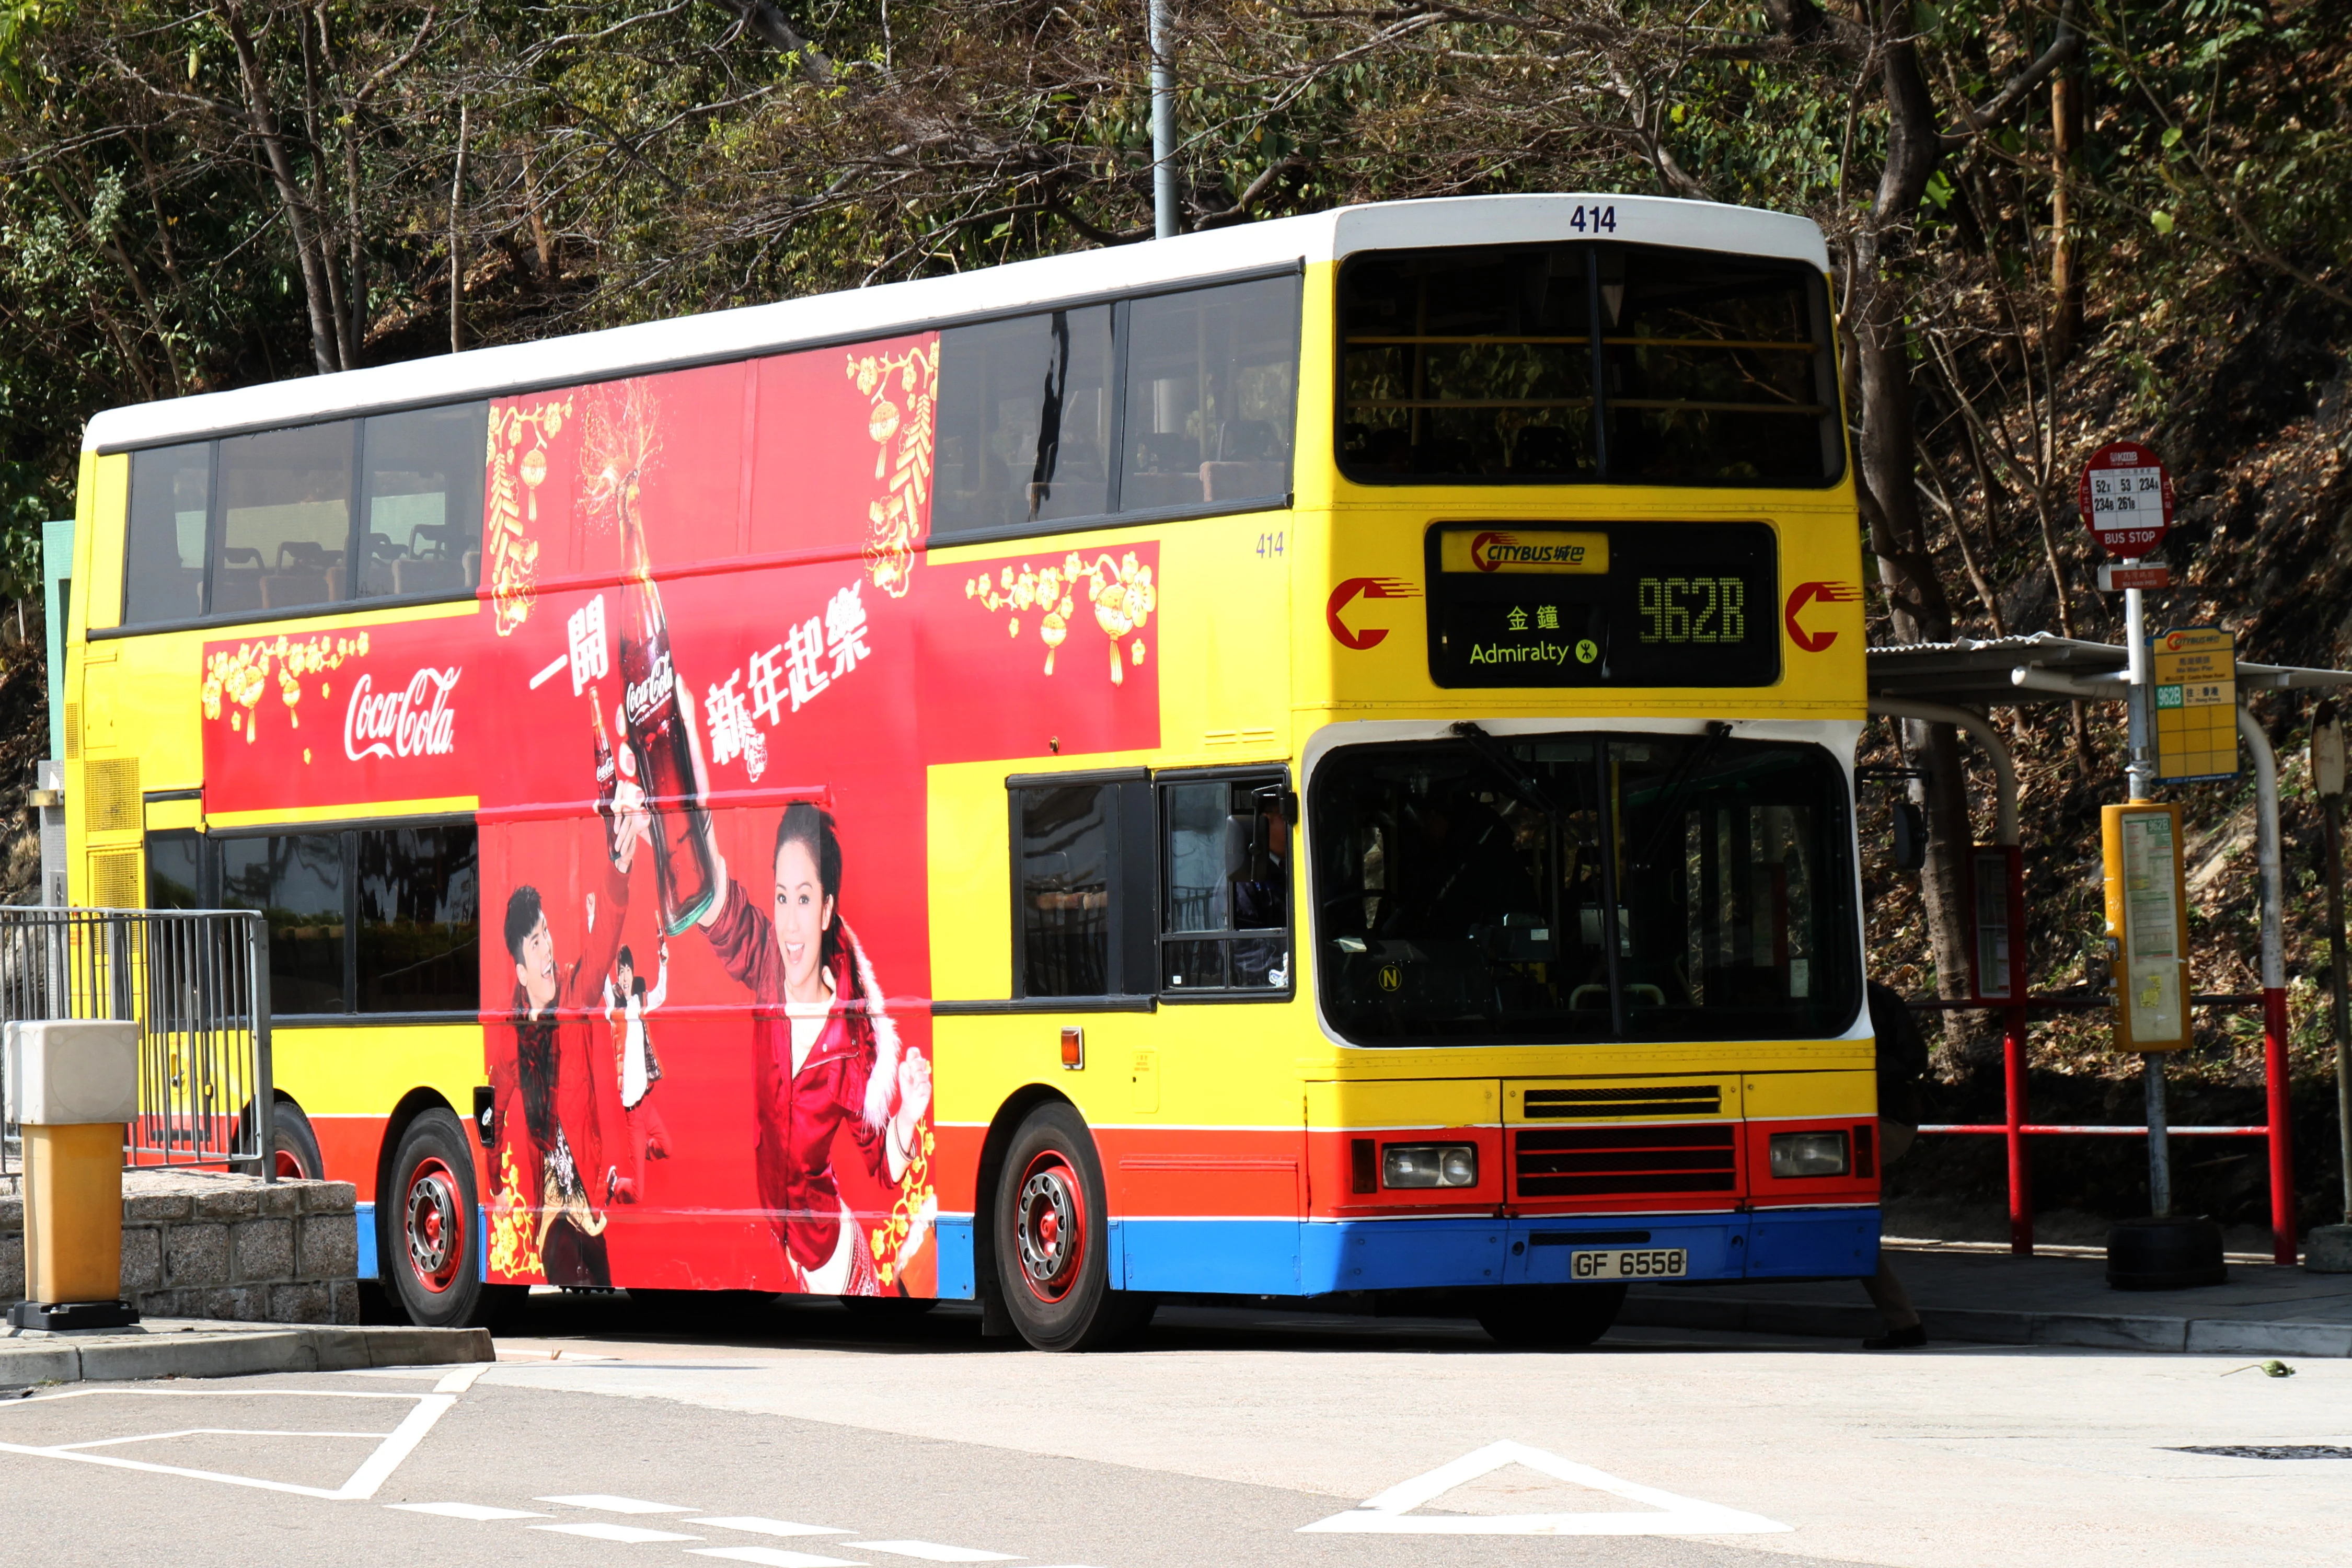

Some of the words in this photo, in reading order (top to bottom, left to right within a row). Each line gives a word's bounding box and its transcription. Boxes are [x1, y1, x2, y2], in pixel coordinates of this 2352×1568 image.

[1570, 205, 1617, 233] 414
[2095, 480, 2112, 493] 52X
[2120, 478, 2131, 492] 53
[2139, 477, 2159, 491] 234A
[2094, 498, 2114, 512] 234B
[2118, 496, 2136, 510] 261B
[1255, 531, 1284, 559] 414
[2105, 532, 2125, 545] BUS
[2129, 531, 2155, 543] STOP
[1487, 545, 1553, 561] CITYBUS
[1553, 545, 1585, 562] 城巴
[1507, 605, 1560, 631] 金鐘
[1639, 578, 1744, 643] 962B
[529, 593, 609, 697] 一開
[1470, 642, 1569, 666] Admiralty
[704, 578, 871, 767] 新年起樂
[626, 650, 673, 723] Coca-Cola
[2158, 686, 2181, 706] 962B
[344, 665, 462, 761] Coca-Cola
[596, 756, 614, 781] Coca-Cola
[2148, 819, 2169, 832] 962B
[1383, 970, 1397, 987] N
[1576, 1253, 1608, 1276] GF
[1620, 1251, 1682, 1275] 6558
